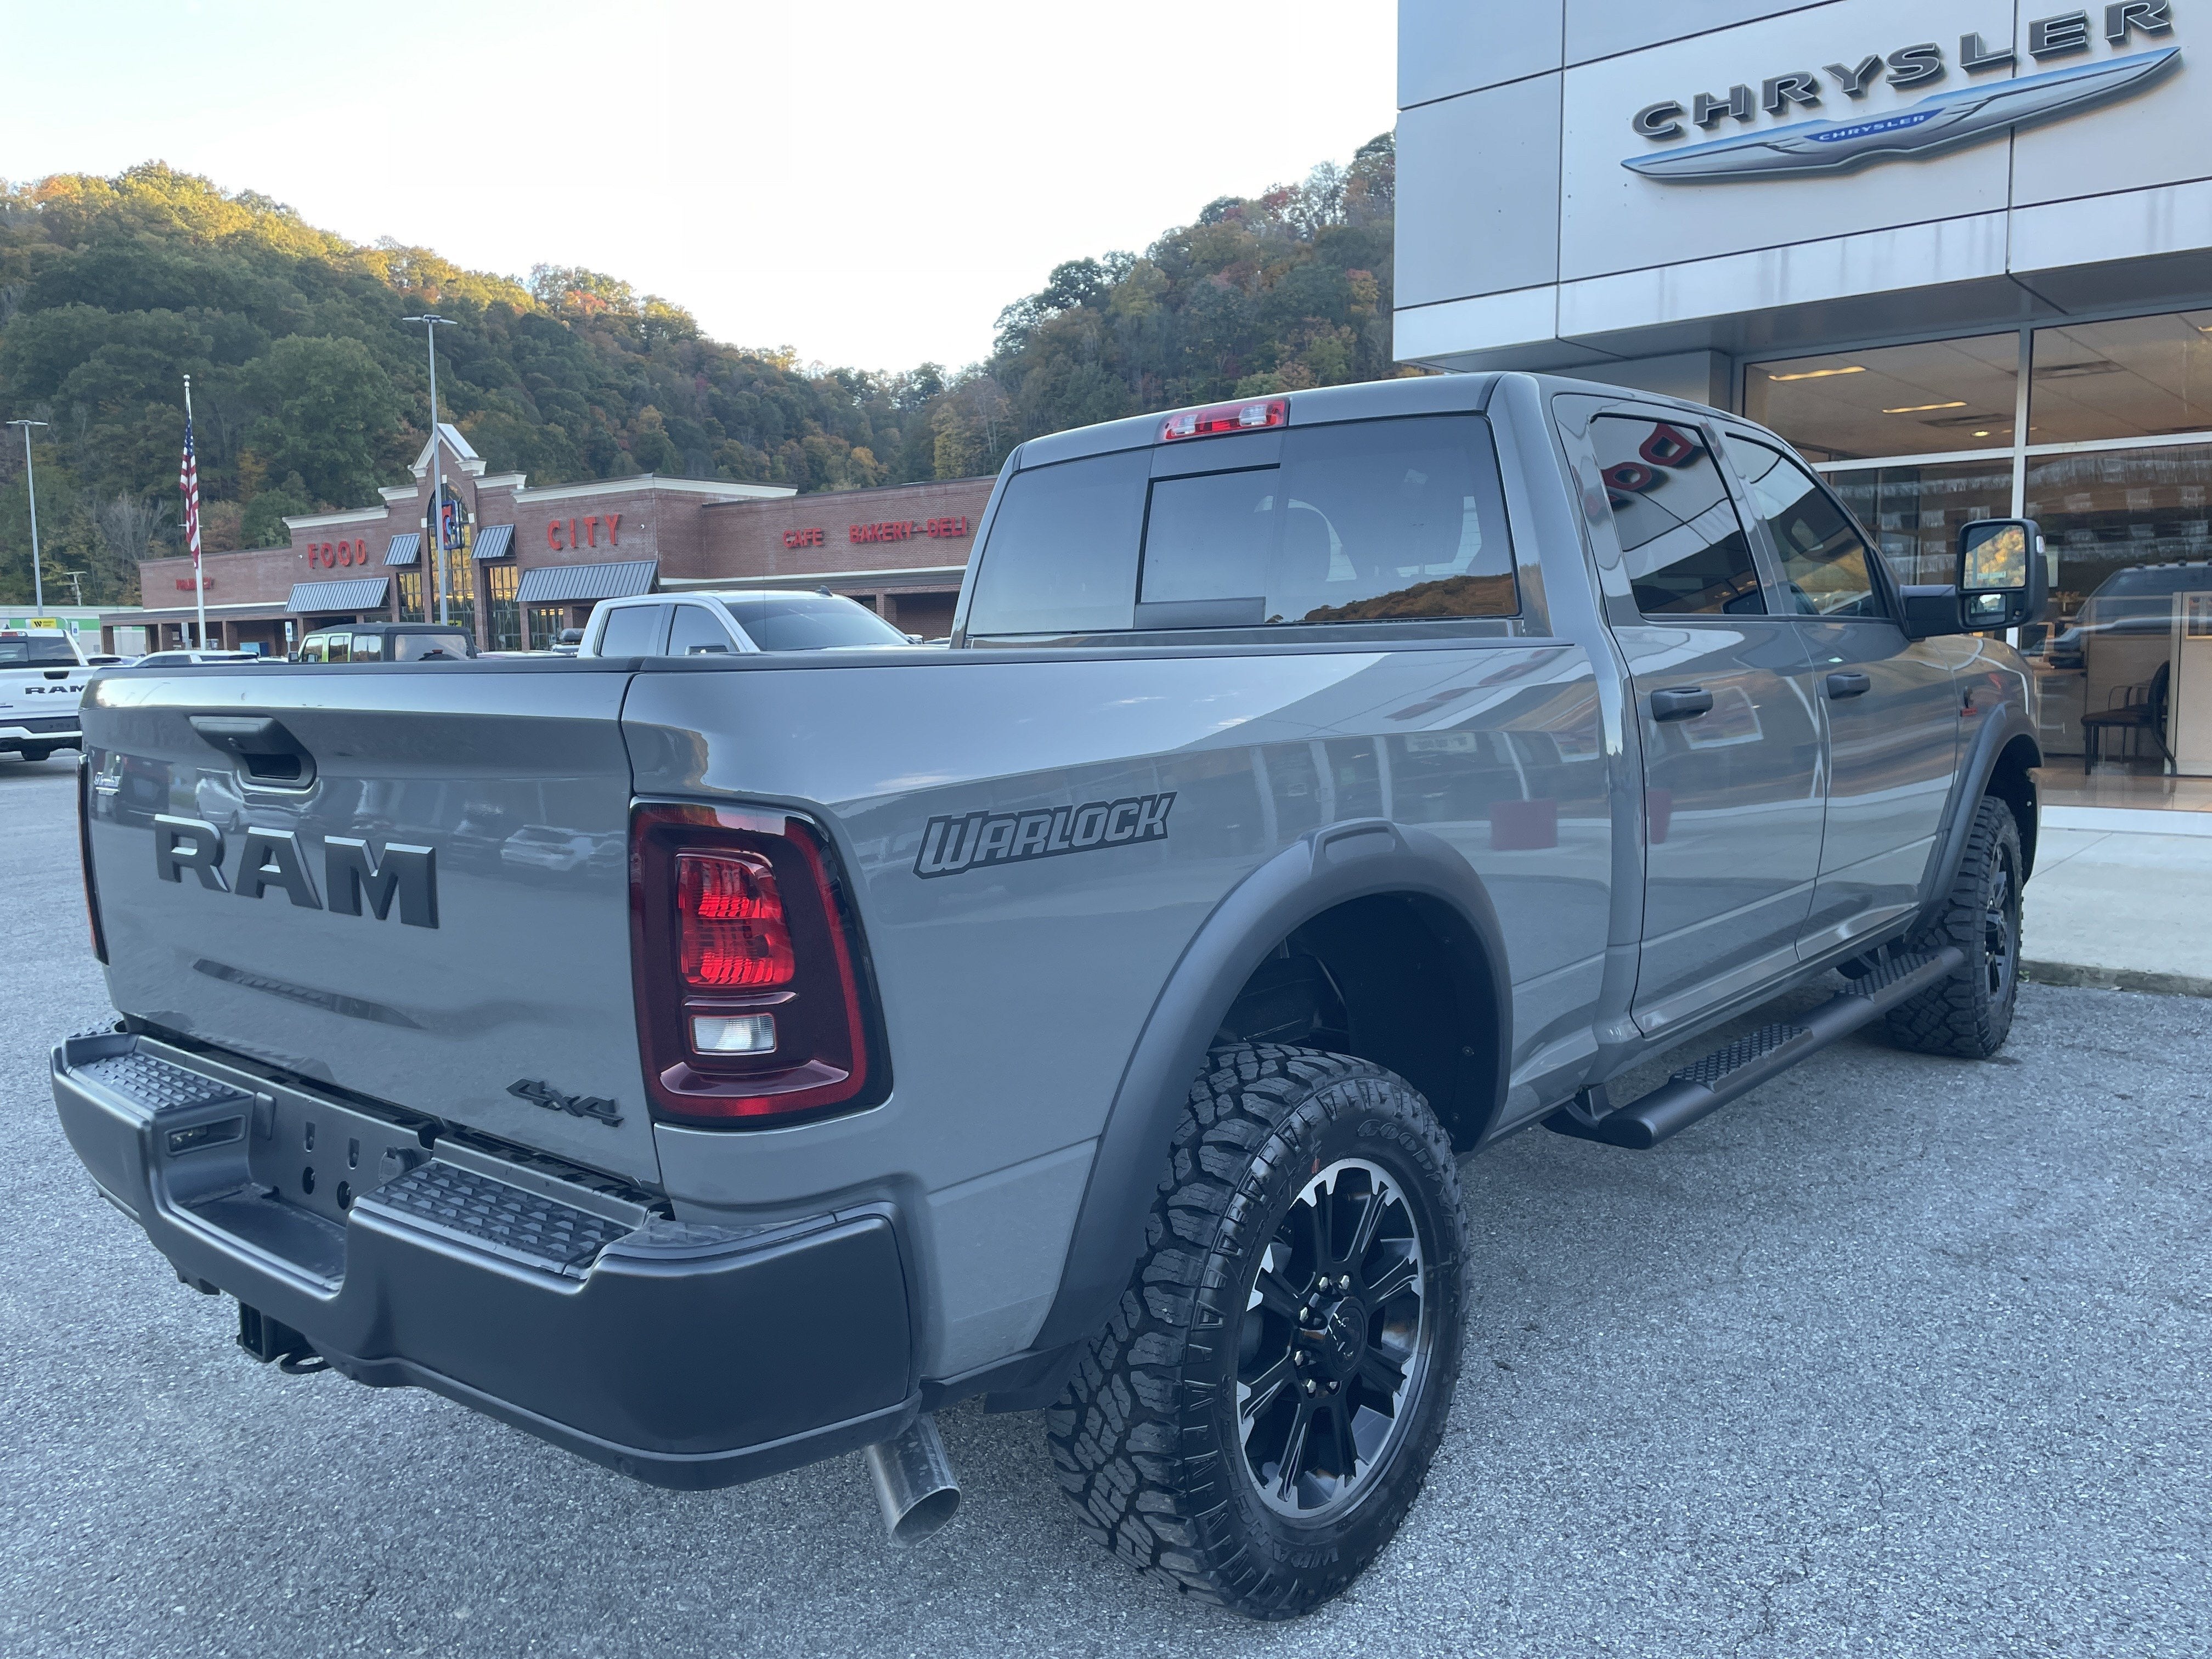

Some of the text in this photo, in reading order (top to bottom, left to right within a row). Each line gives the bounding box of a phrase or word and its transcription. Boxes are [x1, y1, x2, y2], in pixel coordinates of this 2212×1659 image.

[1632, 0, 2171, 137] CHRYSLER
[1819, 115, 1925, 140] CHRYSLER
[547, 514, 620, 551] CITY
[783, 527, 823, 548] CAFE
[307, 539, 366, 569] FOOD
[25, 685, 85, 695] RAM
[912, 791, 1178, 879] WARLOCK
[154, 813, 439, 930] RAM
